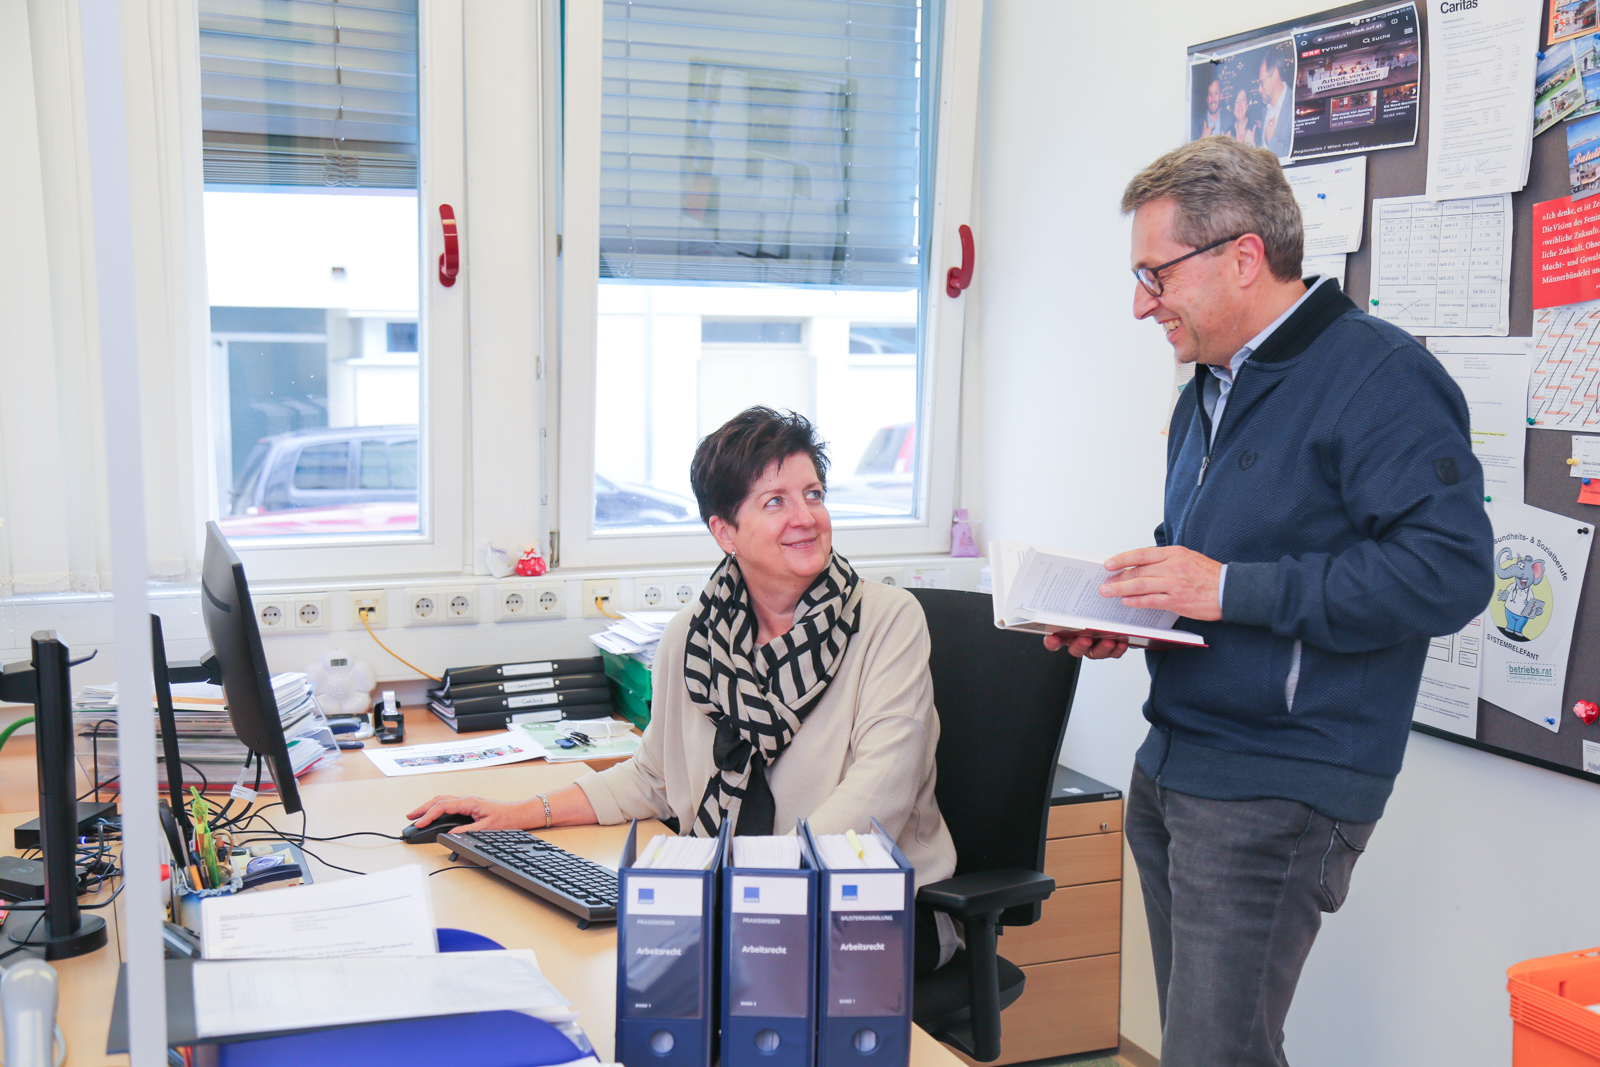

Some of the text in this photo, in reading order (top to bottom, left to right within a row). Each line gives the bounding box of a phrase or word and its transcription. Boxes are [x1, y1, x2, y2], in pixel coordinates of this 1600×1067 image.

[1440, 0, 1478, 14] Caritas
[1371, 33, 1391, 42] Suche
[1321, 43, 1348, 53] TVTHEK
[1317, 82, 1335, 90] man
[1336, 78, 1359, 87] leben
[1321, 75, 1348, 85] Arbeit,
[1557, 208, 1576, 218] denke,
[1542, 226, 1552, 234] Die
[1553, 221, 1572, 230] Vision
[1574, 218, 1583, 226] des
[1542, 250, 1556, 259] liche
[1558, 245, 1584, 256] Zukunft.
[1542, 262, 1565, 271] Macht-
[1567, 258, 1578, 266] und
[1542, 268, 1590, 284] Männerbündelei
[1494, 533, 1528, 544] sundheits-
[1536, 540, 1568, 581] Sozialberufe
[1486, 634, 1539, 660] SYSTEMRELEFANT
[1509, 665, 1552, 675] betriebs.rat
[636, 947, 682, 956] Arbeitsrecht
[742, 945, 787, 954] Arbeitsrecht
[840, 942, 885, 951] Arbeitsrecht
